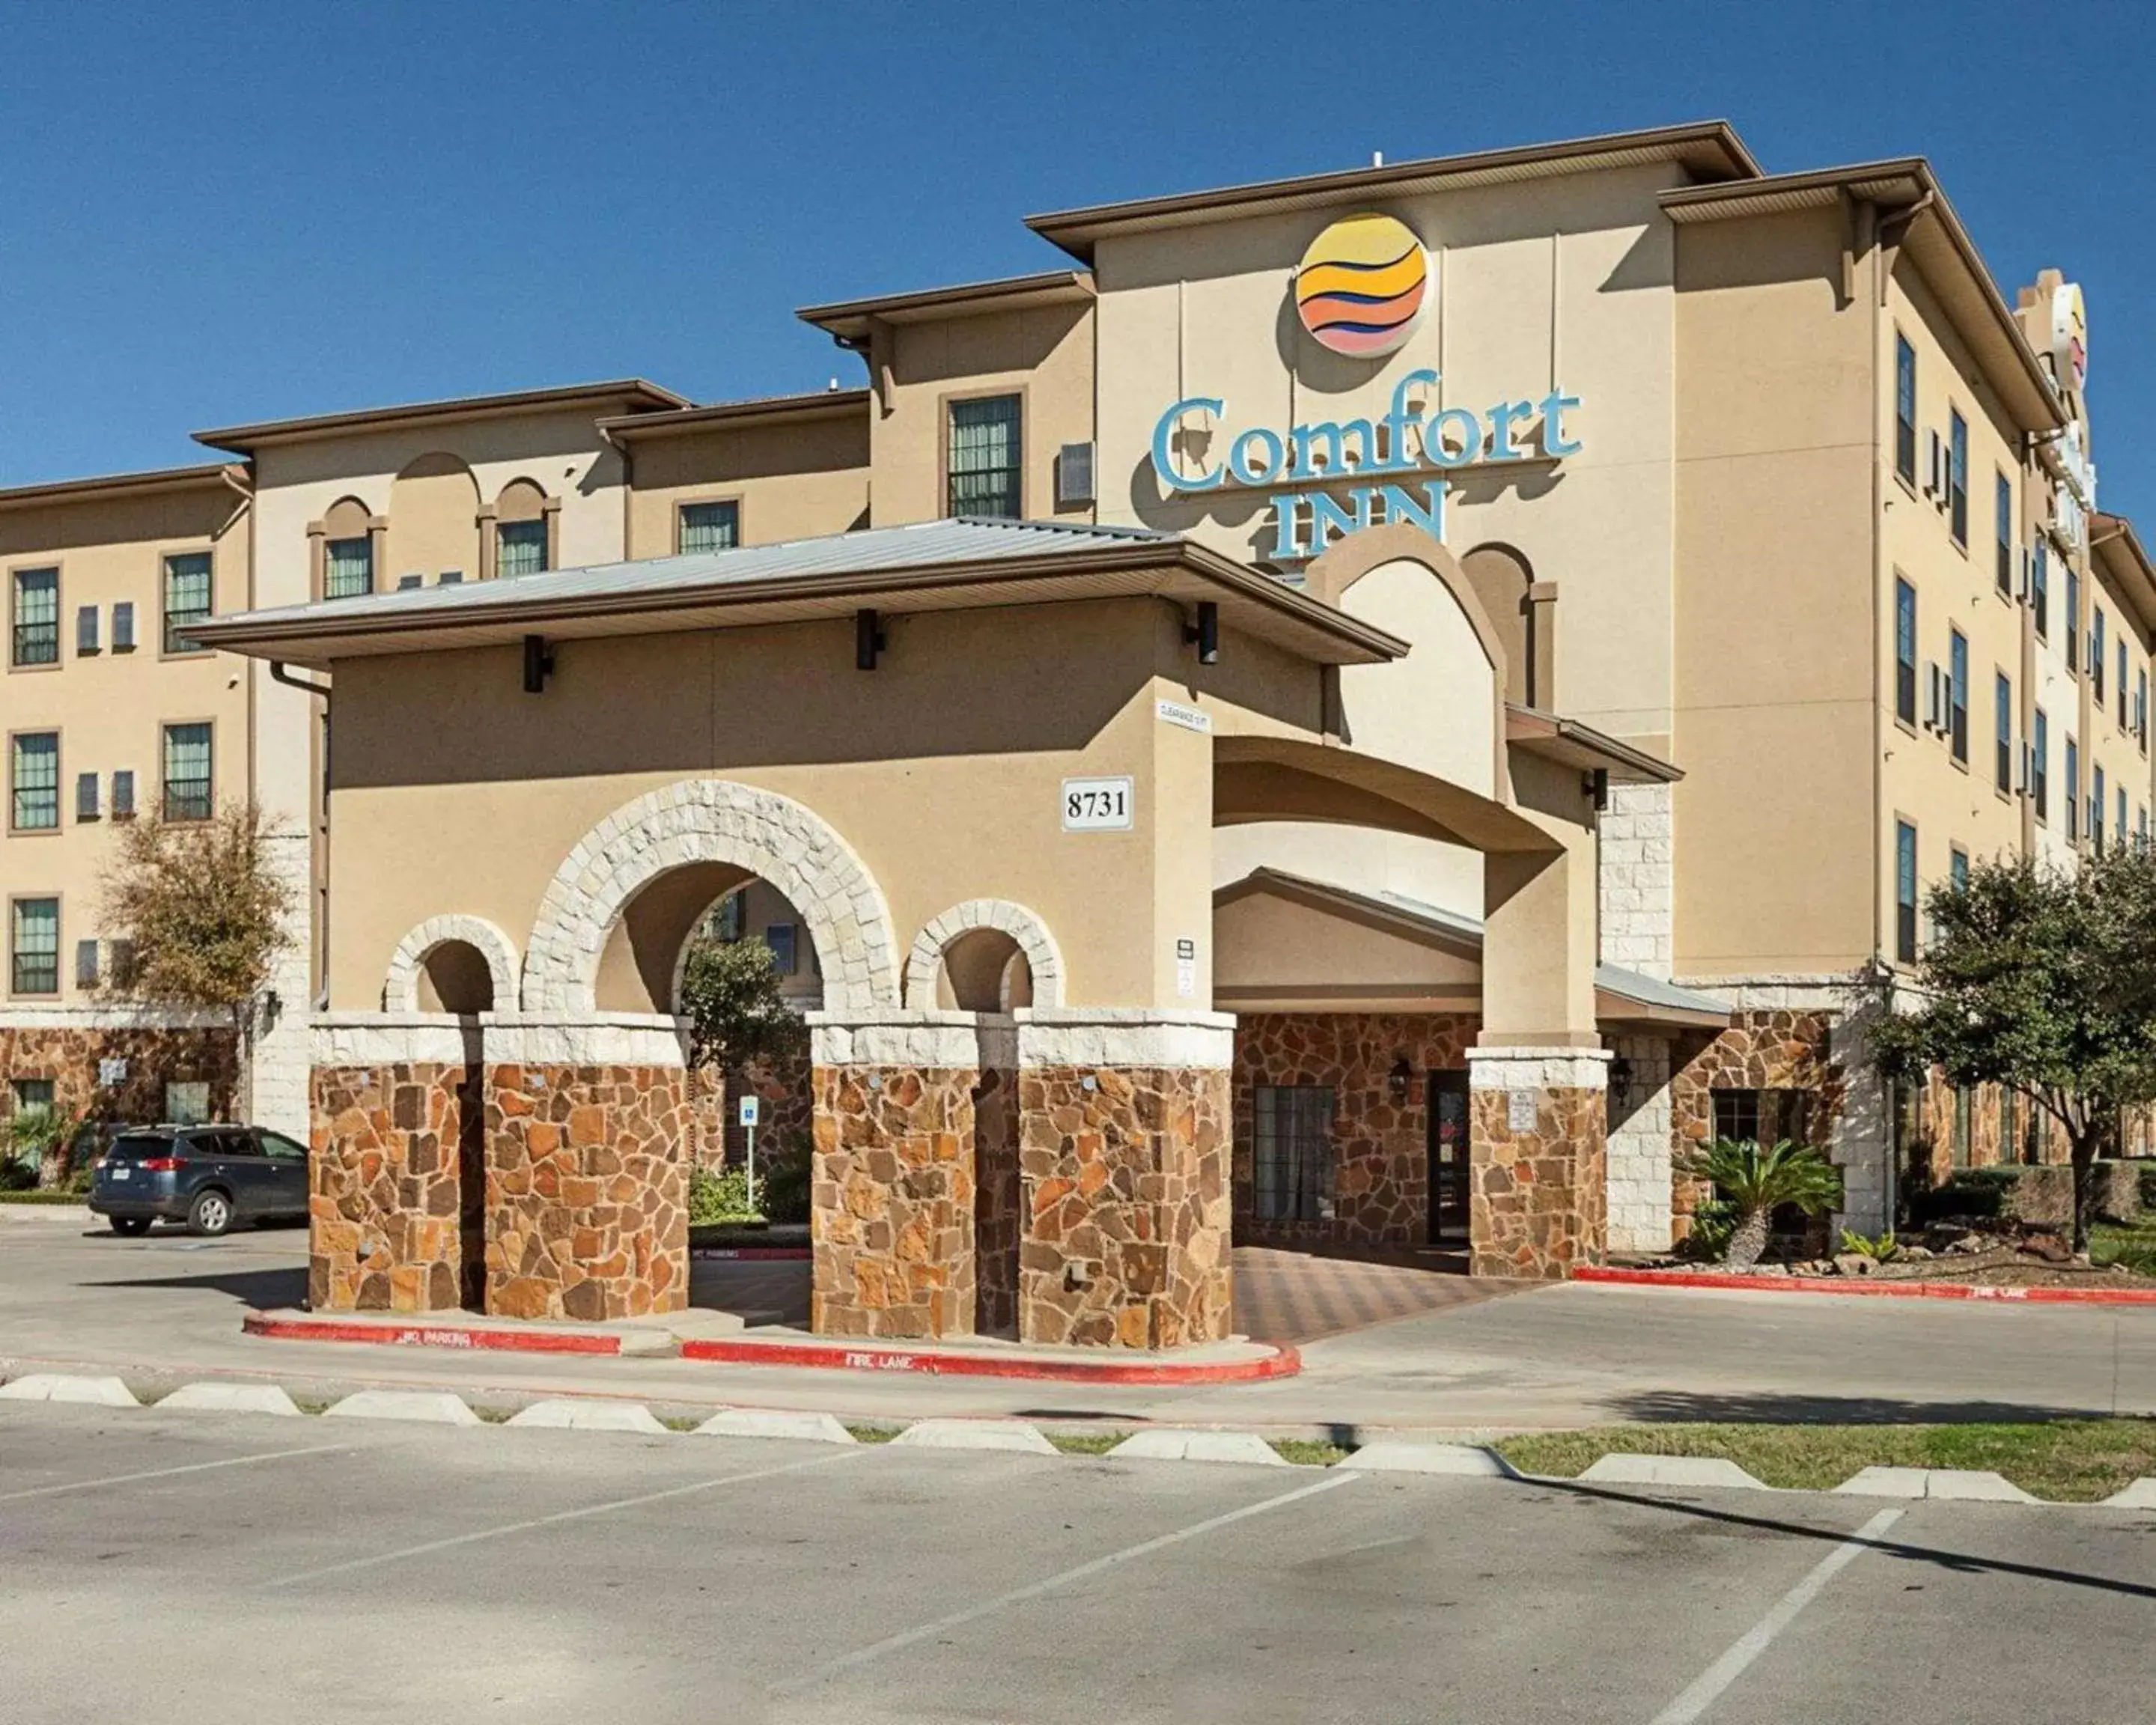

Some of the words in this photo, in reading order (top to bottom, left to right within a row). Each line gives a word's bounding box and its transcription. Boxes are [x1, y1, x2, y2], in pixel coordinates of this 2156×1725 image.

[1151, 368, 1585, 492] Comfort
[1068, 791, 1124, 818] 8731
[846, 1353, 874, 1368] FIRE
[879, 1354, 913, 1369] LANE
